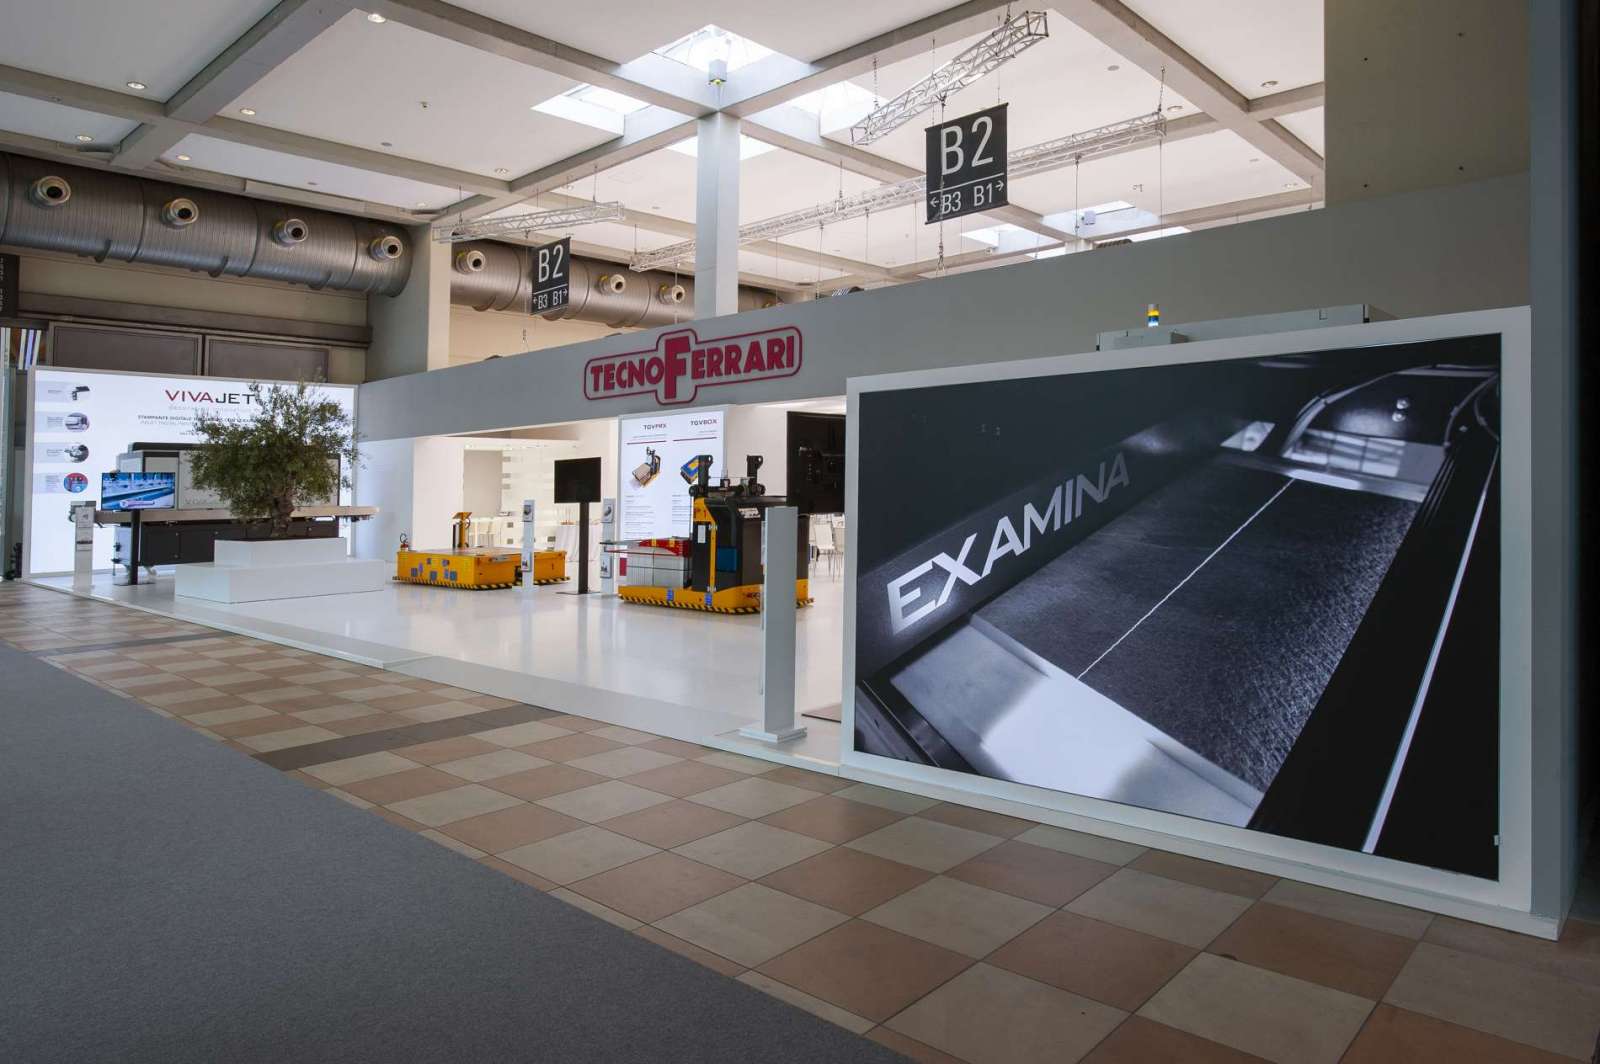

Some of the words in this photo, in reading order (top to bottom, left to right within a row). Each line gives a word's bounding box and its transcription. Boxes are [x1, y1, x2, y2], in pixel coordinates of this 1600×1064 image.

[941, 116, 993, 176] B2
[942, 191, 962, 215] B3
[974, 183, 993, 207] B1
[538, 244, 564, 282] B2
[538, 294, 548, 310] B3
[553, 289, 562, 306] B1
[165, 389, 256, 405] VIVAJET
[887, 451, 1130, 635] EXAMINA
